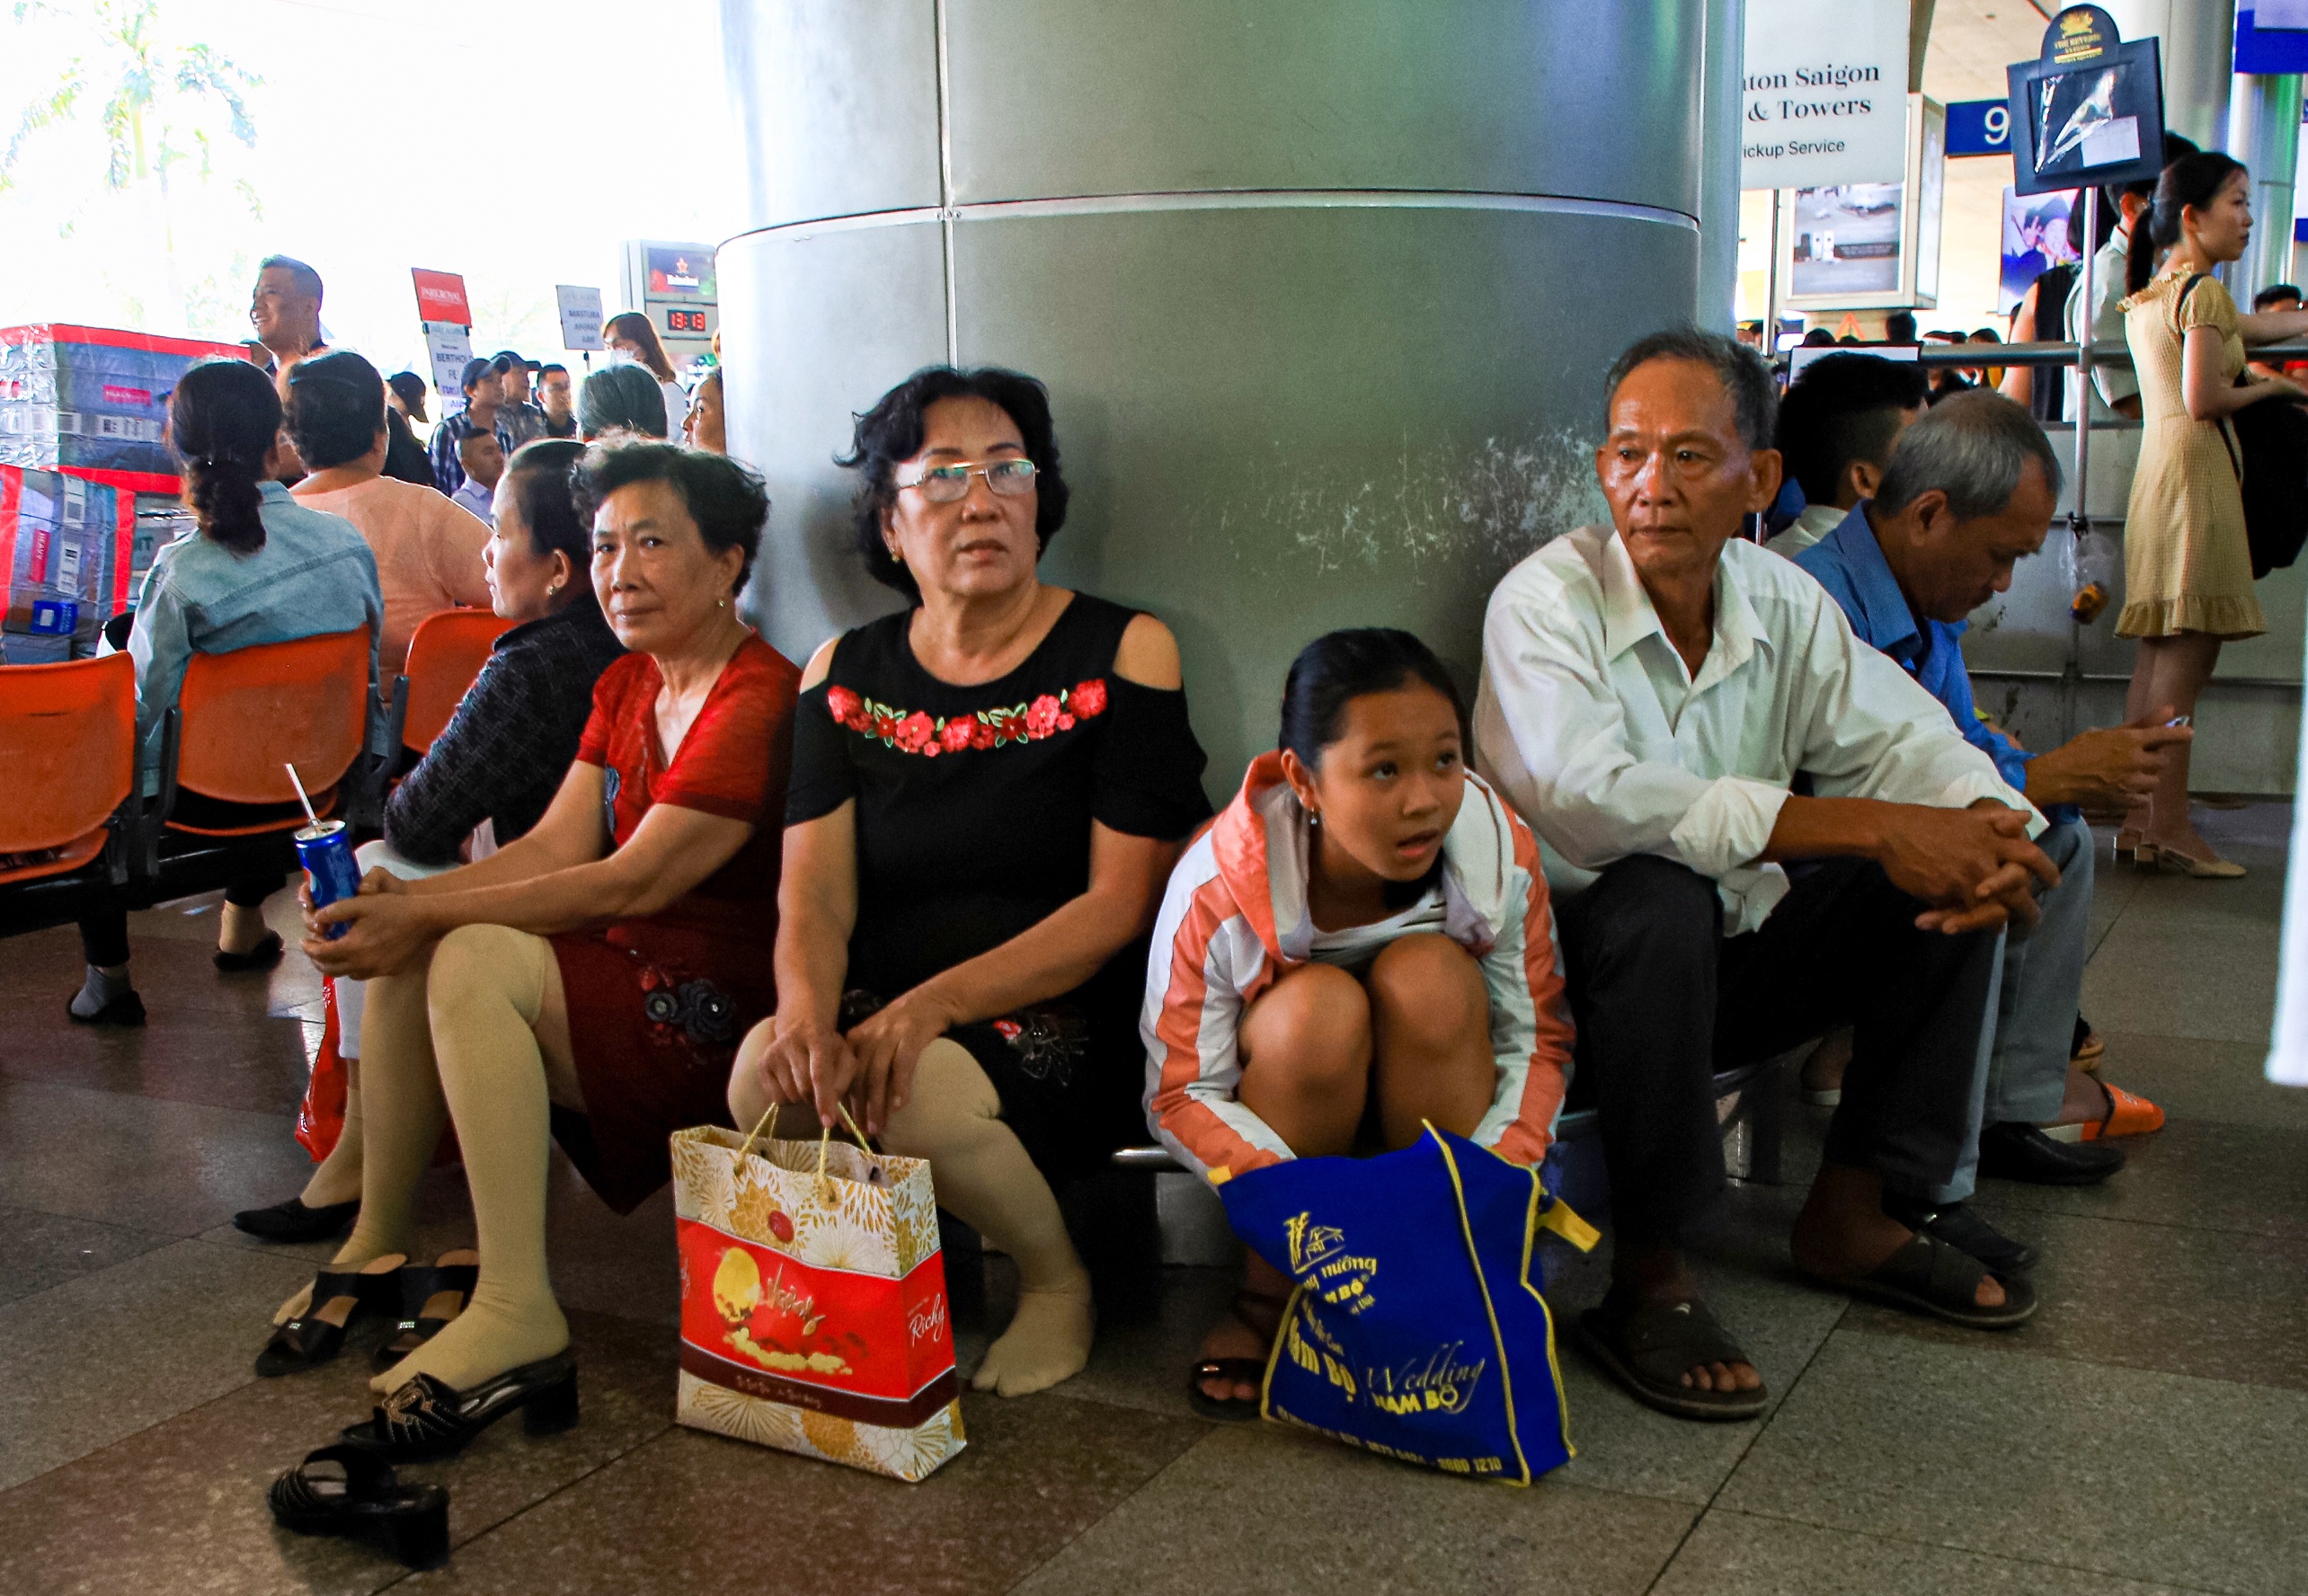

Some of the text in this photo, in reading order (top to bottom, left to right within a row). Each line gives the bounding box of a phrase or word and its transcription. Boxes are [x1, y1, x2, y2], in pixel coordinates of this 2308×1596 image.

[1743, 64, 1879, 92] ton Saigon
[1748, 99, 1871, 121] & Towers
[1984, 106, 2011, 145] 9
[1743, 139, 1845, 159] ickup Service
[670, 312, 706, 330] 13:13
[35, 530, 46, 560] HEAVY
[909, 1292, 945, 1347] Richy
[1367, 1339, 1486, 1414] Wedding
